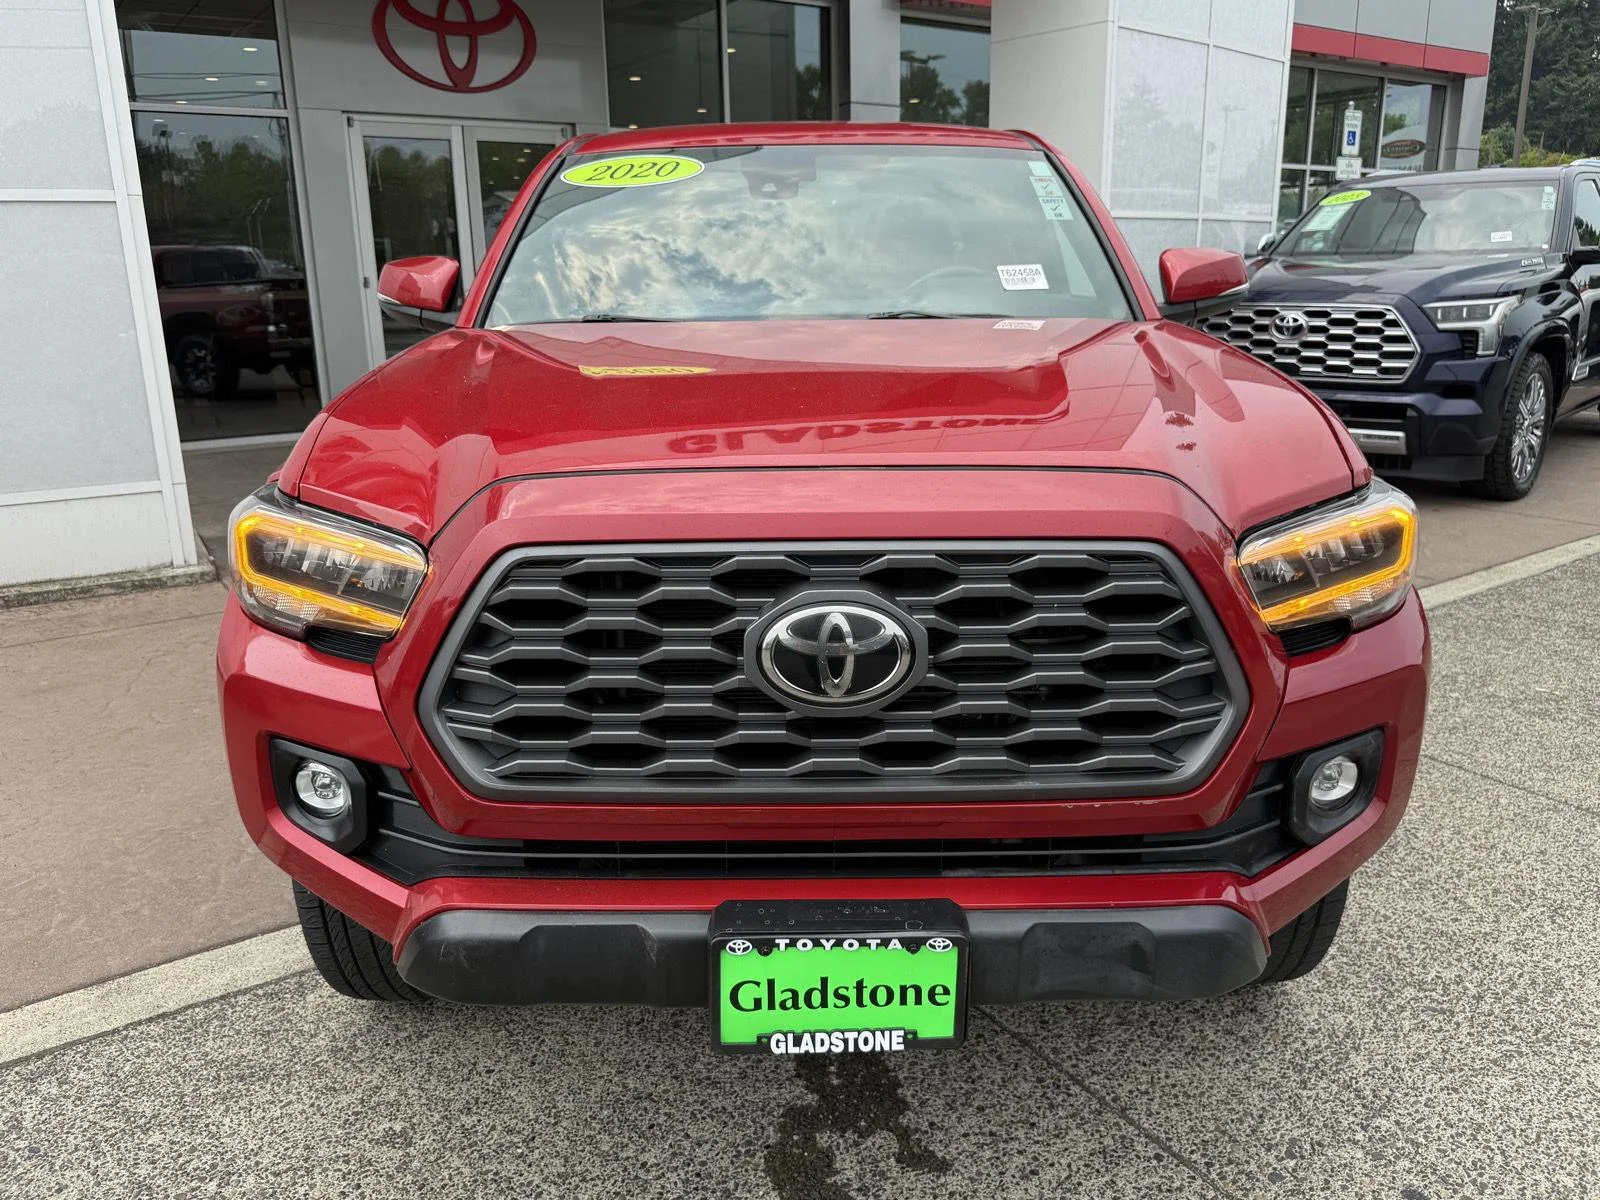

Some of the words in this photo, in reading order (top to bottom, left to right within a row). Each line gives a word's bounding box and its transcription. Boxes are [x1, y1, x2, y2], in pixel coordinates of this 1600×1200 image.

[585, 160, 680, 182] 2020
[775, 938, 903, 951] TOYOTA
[729, 976, 951, 1012] Gladstone
[770, 1029, 905, 1054] GLADSTONE
